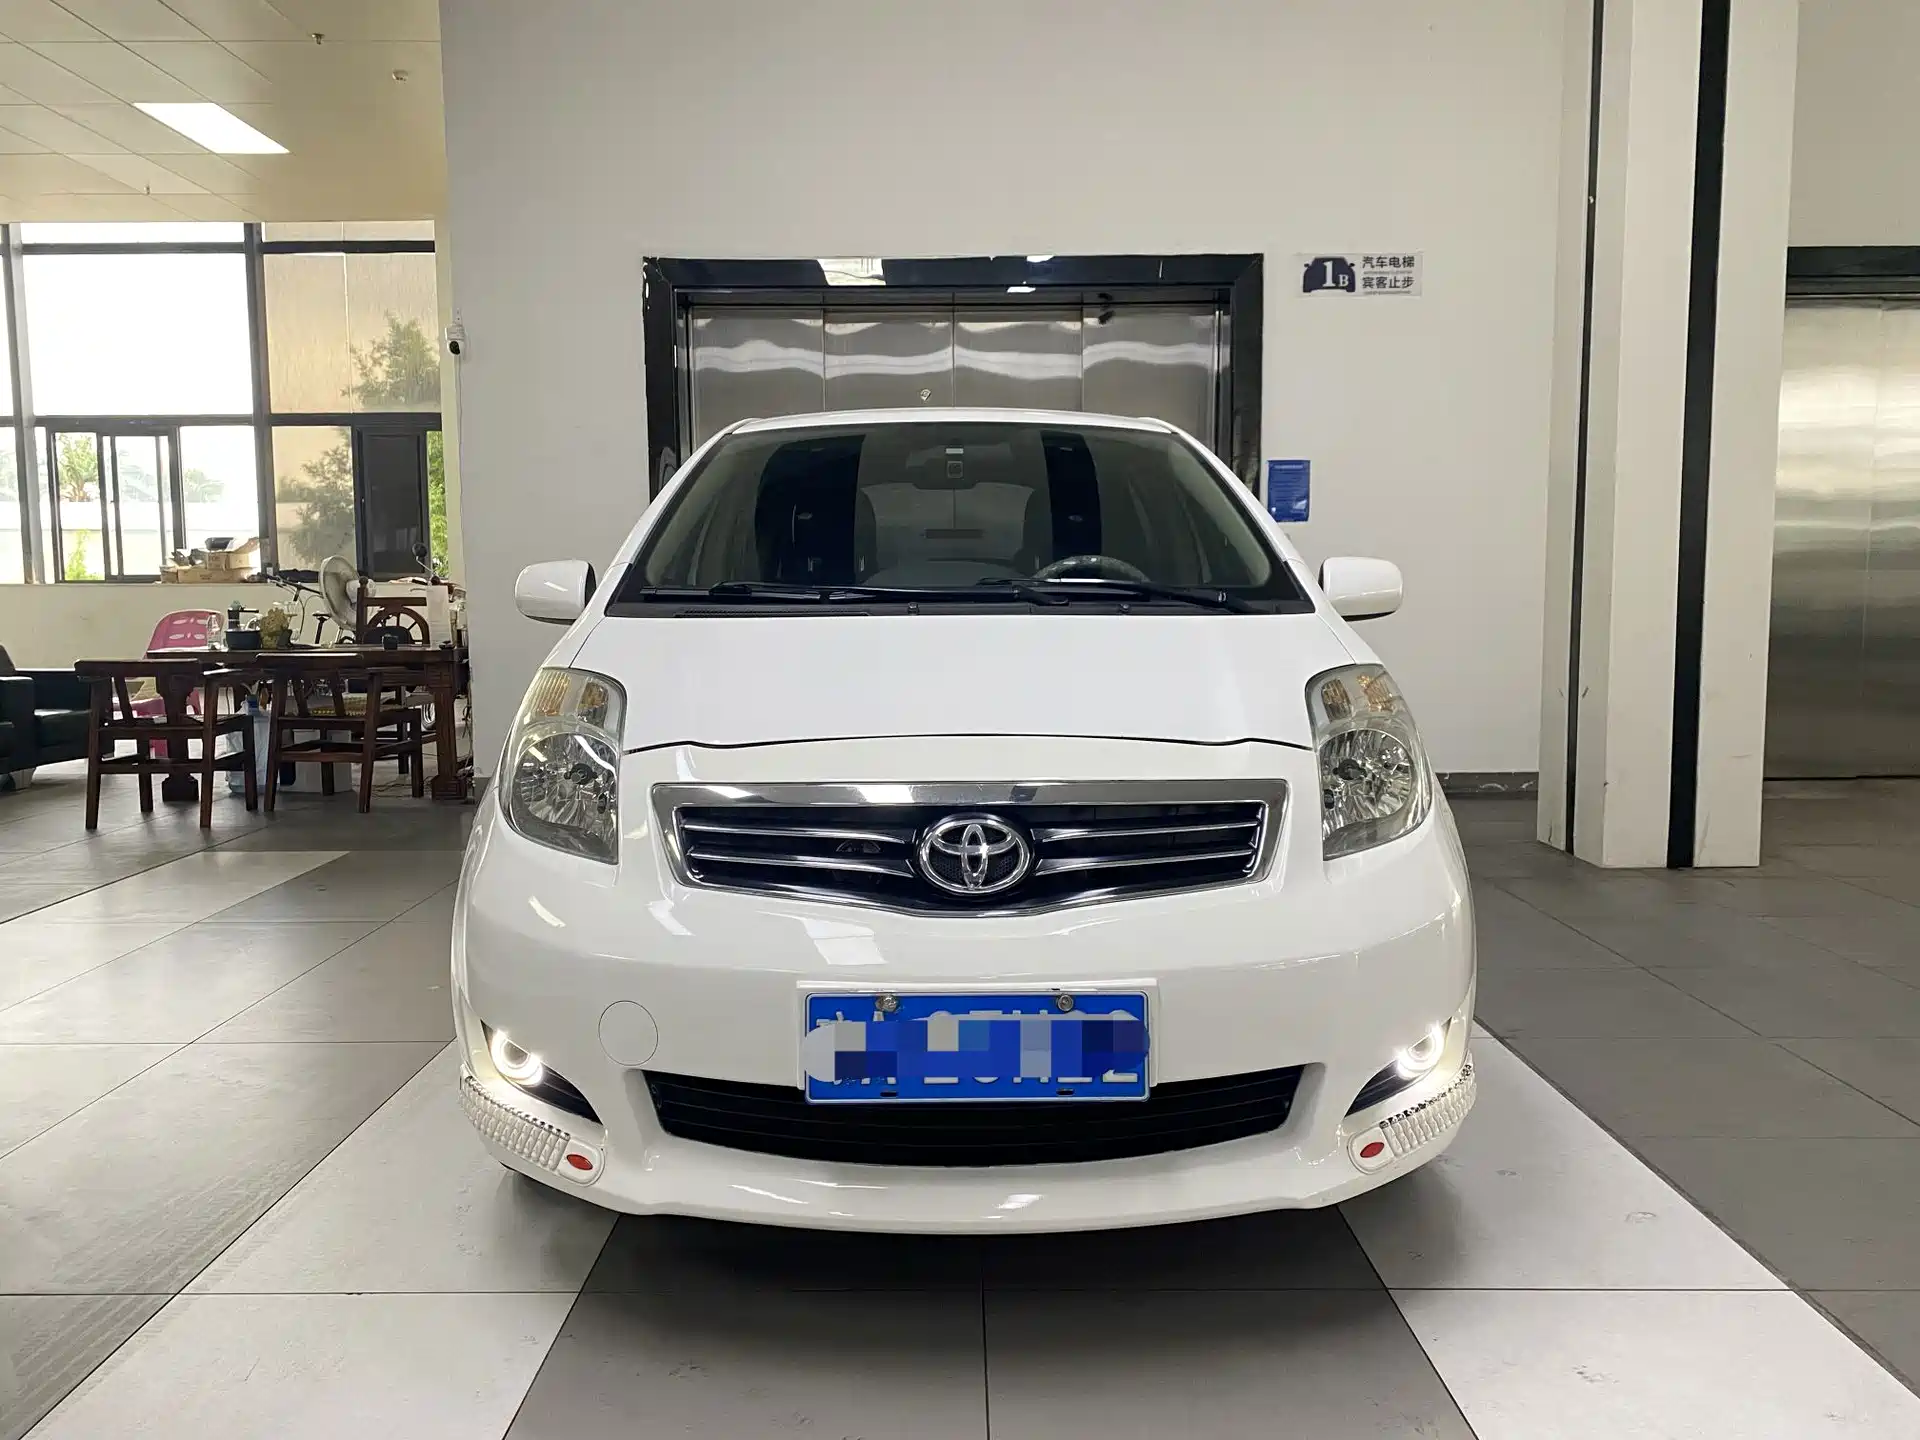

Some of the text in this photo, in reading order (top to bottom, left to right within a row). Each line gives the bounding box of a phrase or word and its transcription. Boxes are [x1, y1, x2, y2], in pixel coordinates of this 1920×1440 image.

[1362, 256, 1415, 269] 汽车电梯
[1362, 276, 1415, 289] 宾客止步
